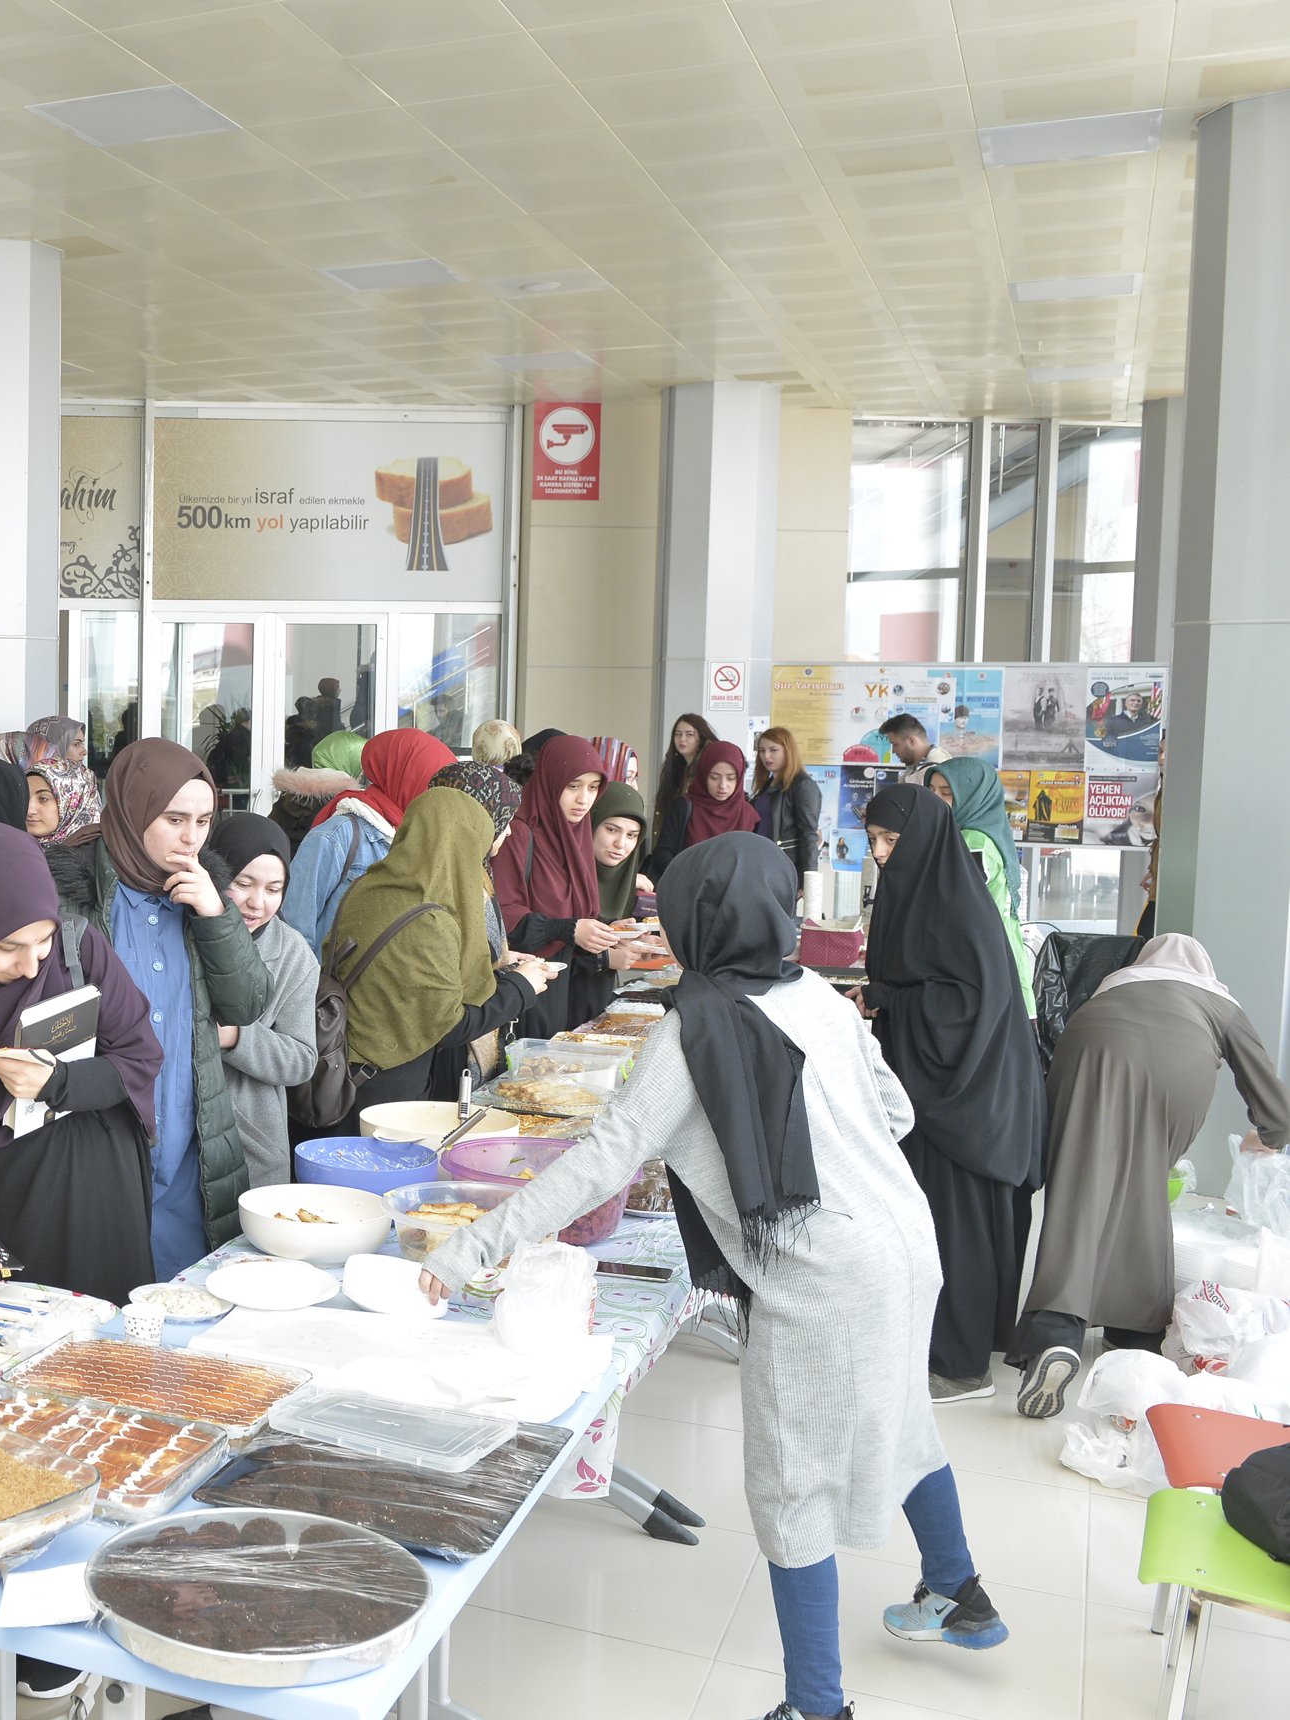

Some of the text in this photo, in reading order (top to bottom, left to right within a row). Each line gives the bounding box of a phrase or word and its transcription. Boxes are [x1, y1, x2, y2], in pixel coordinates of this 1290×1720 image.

[178, 487, 366, 506] Ülkemizde bir yıl israf edilen ekmekle
[257, 514, 284, 533] yol
[289, 514, 369, 533] yapılabilir
[1090, 784, 1121, 794] YEMEN
[1089, 795, 1132, 806] AÇLIKTAN
[1088, 805, 1126, 817] ÖLÜYOR!
